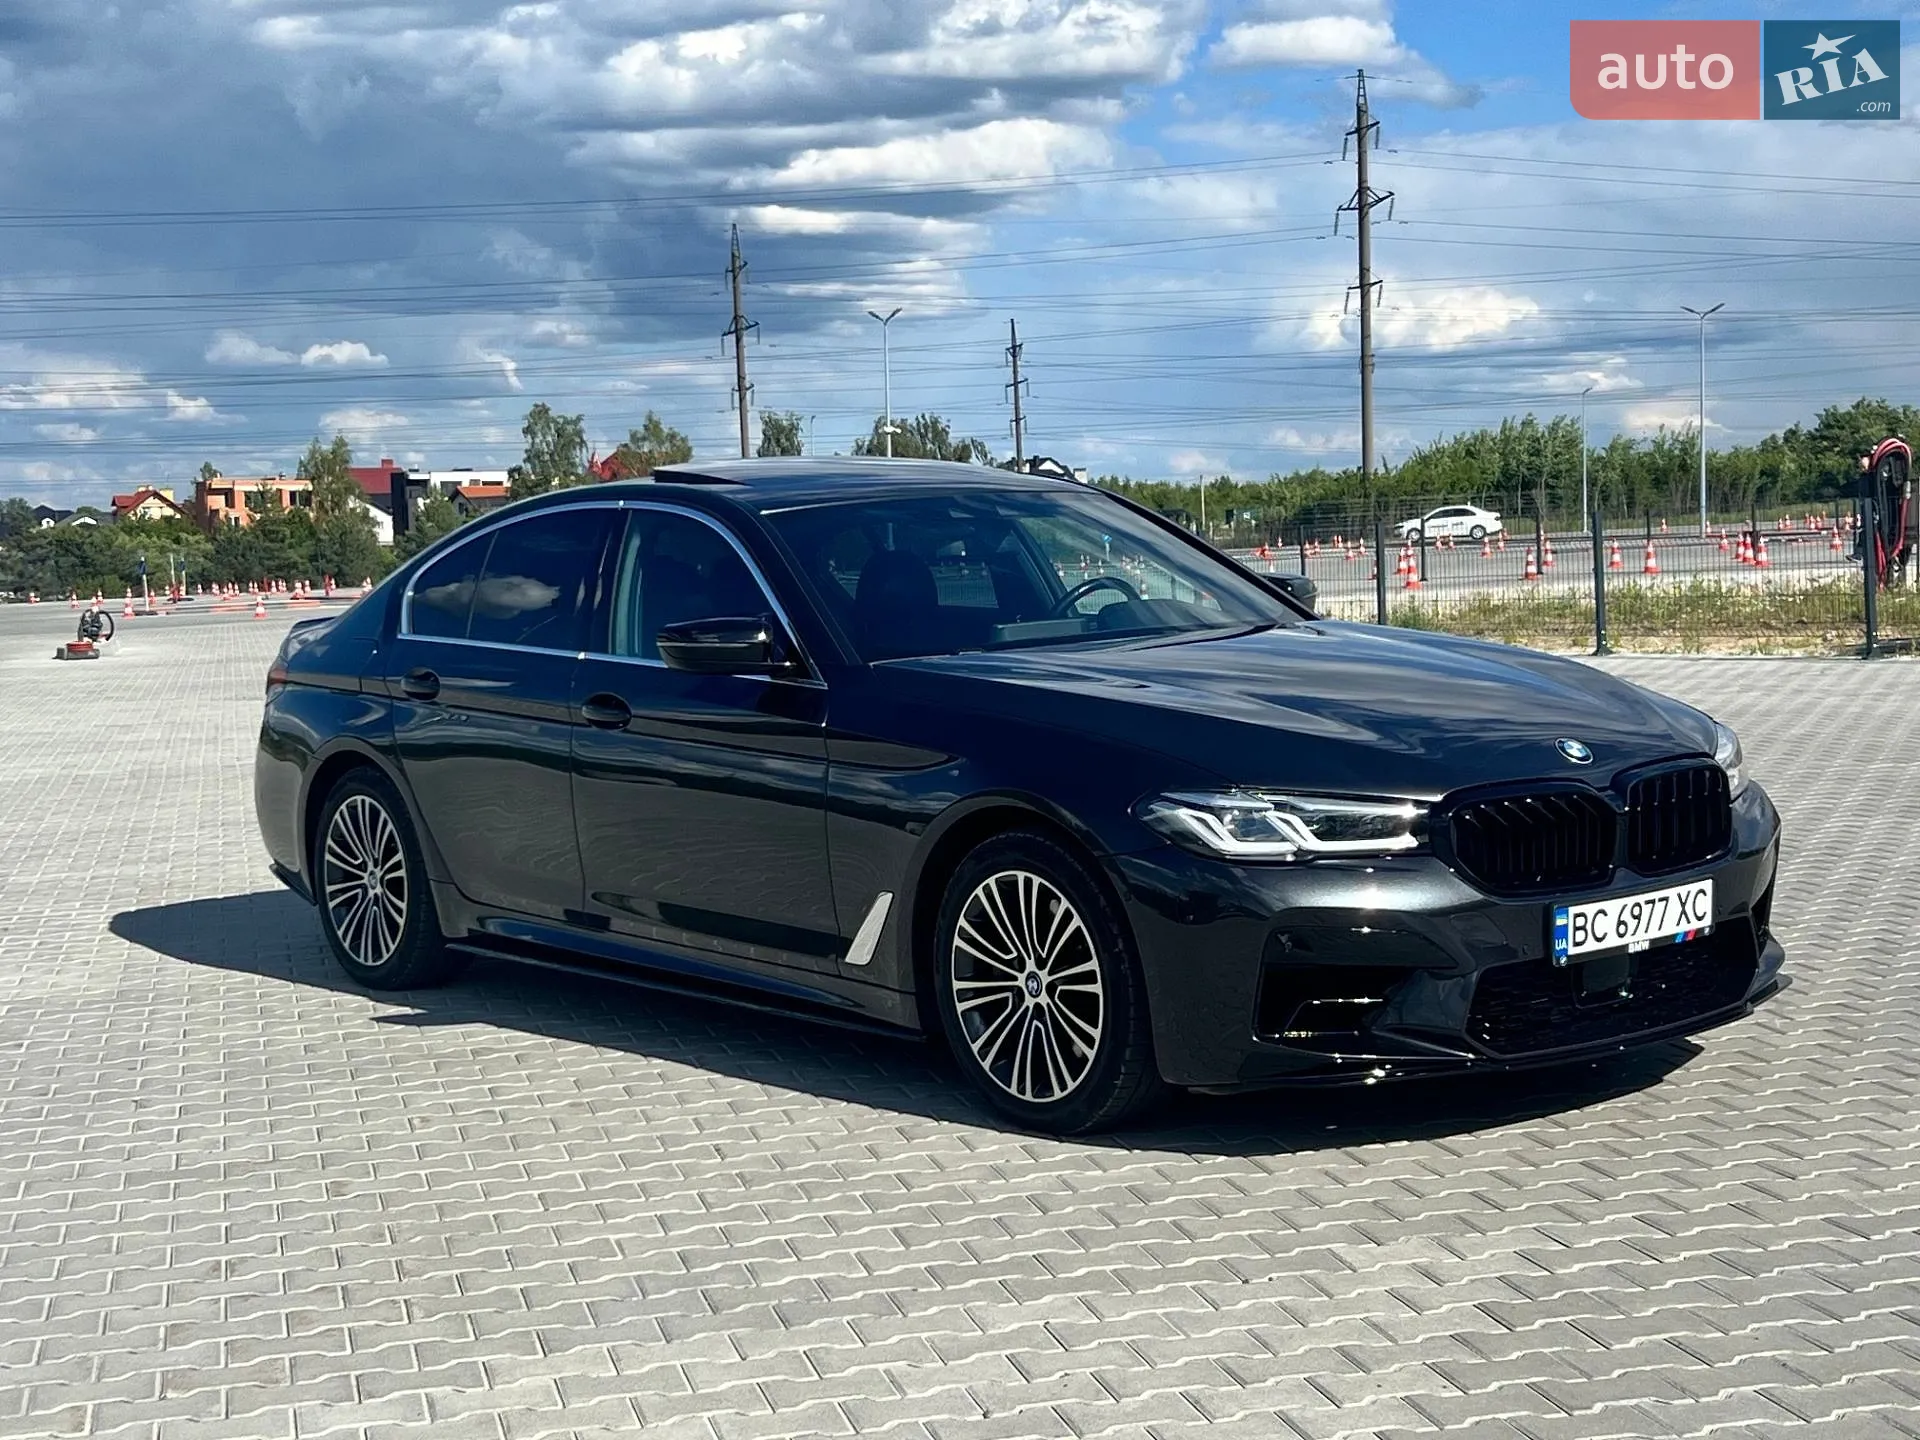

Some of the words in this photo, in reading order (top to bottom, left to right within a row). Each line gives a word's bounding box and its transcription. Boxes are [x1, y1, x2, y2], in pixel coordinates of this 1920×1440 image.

[1572, 908, 1608, 948] BC
[1615, 896, 1670, 939] 6977
[1675, 888, 1708, 927] XC
[1555, 939, 1568, 950] UA
[1628, 940, 1650, 954] BMW
